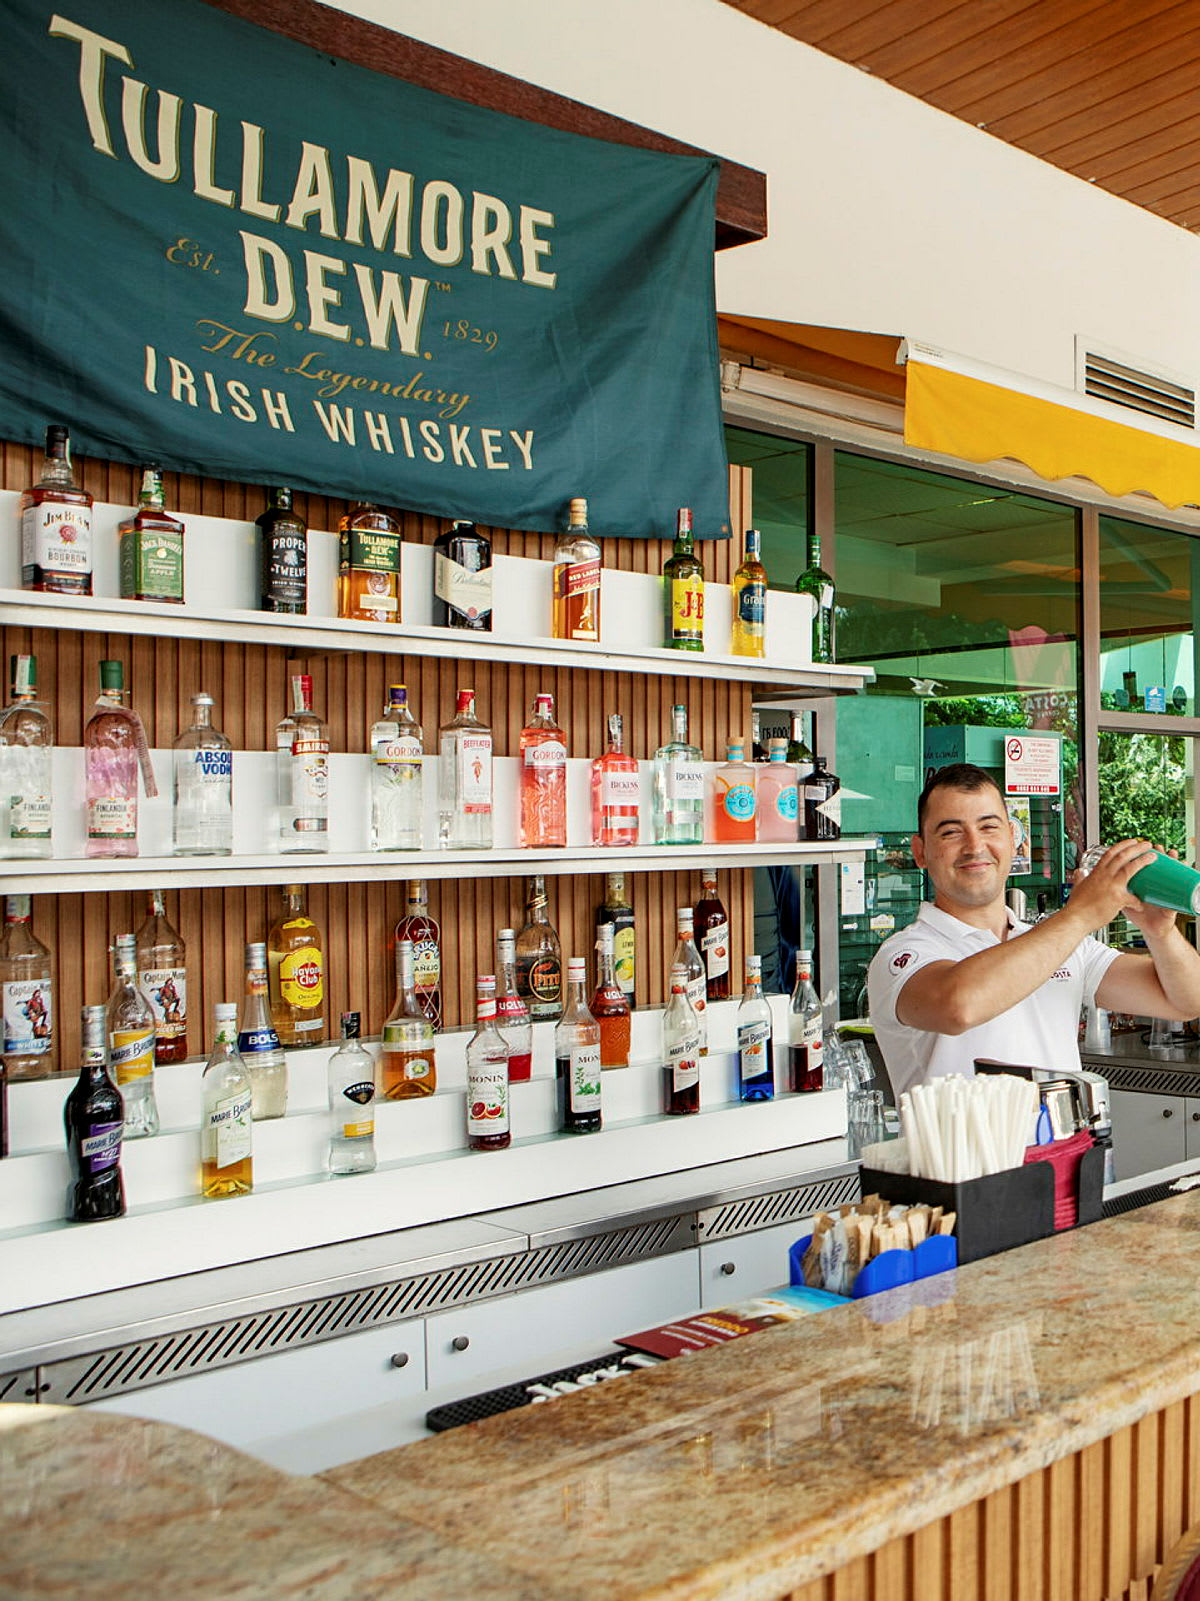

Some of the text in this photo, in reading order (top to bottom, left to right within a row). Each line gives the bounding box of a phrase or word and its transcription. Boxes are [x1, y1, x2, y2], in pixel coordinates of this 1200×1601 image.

[48, 14, 557, 290] TULLAMORE
[165, 237, 222, 276] Est.
[442, 319, 499, 352] 1829
[196, 318, 471, 419] The Legendary
[144, 345, 536, 472] IRISH WHISKEY
[300, 973, 319, 985] Club
[248, 1033, 279, 1046] BOLS
[210, 1109, 231, 1124] MARIE
